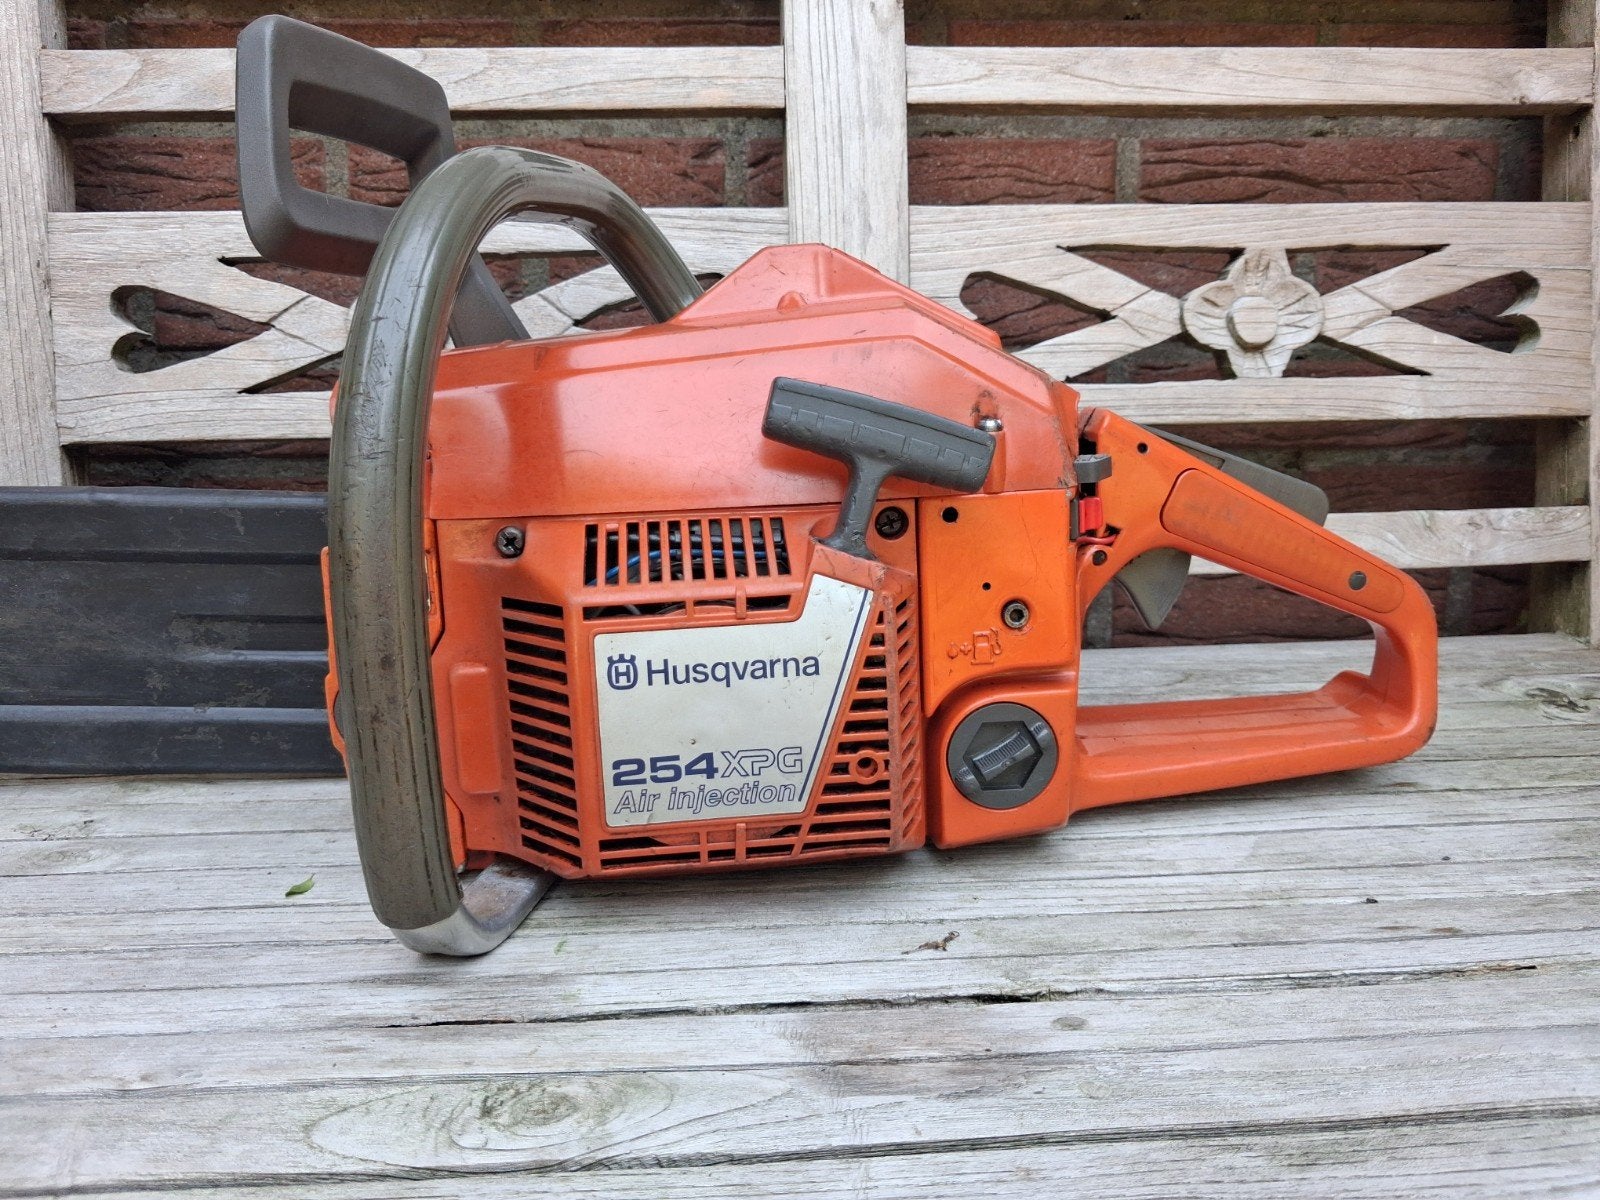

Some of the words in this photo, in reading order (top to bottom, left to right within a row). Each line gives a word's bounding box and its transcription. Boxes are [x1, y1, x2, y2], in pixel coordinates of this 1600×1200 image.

[646, 655, 820, 688] Husqvarna
[614, 790, 661, 814] Air
[668, 780, 796, 815] injection
